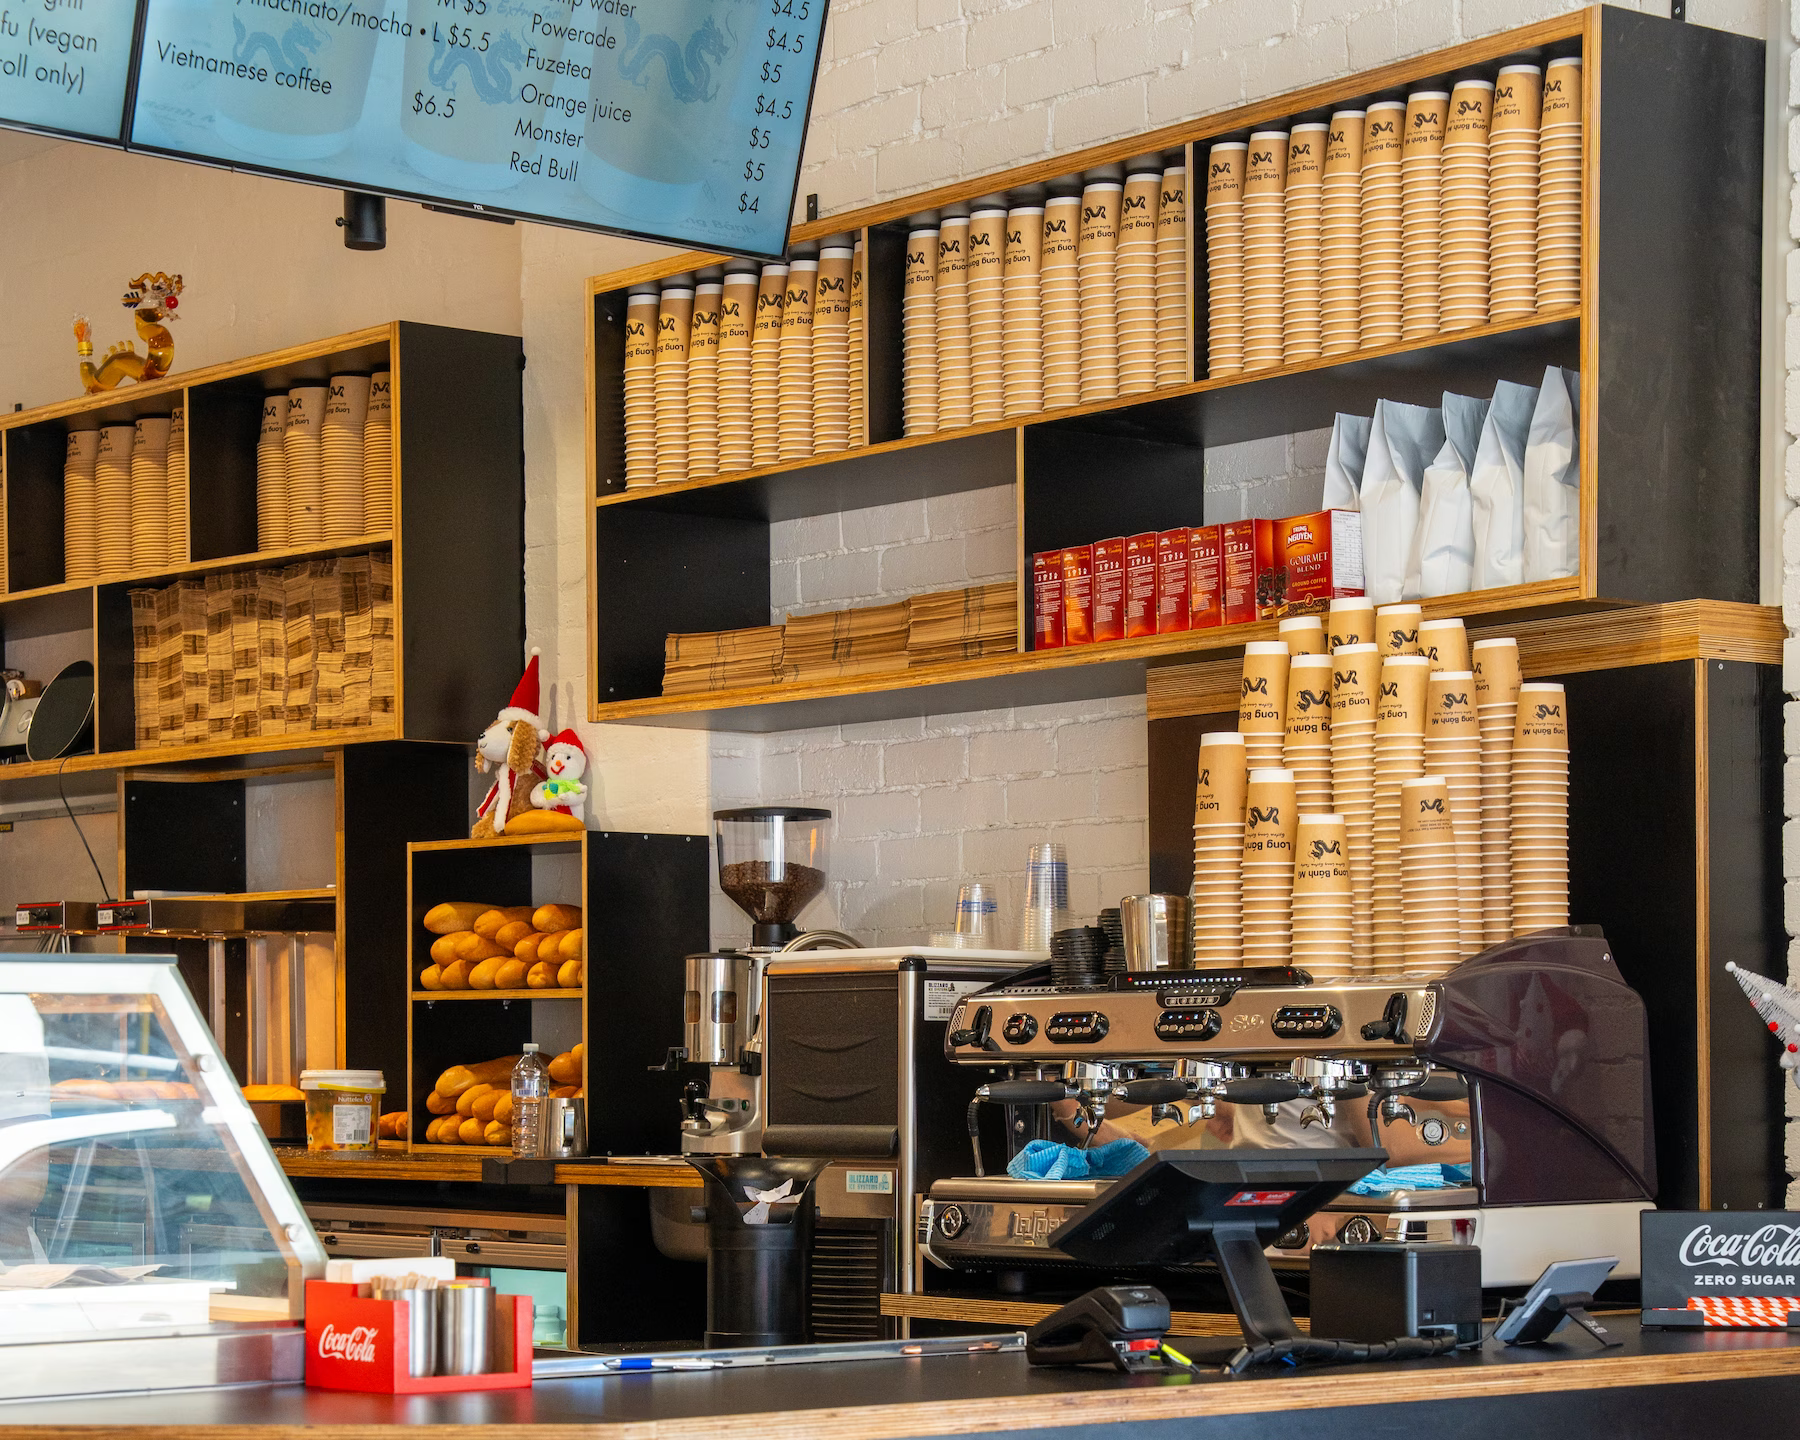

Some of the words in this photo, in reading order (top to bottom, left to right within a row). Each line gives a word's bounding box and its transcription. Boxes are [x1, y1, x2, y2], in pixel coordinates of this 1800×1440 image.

[463, 0, 487, 15] $5
[589, 0, 637, 18] water
[771, 0, 810, 20] $4.5
[236, 0, 412, 37] achiato/mocha
[433, 22, 440, 42] L
[447, 23, 491, 52] $5.5
[531, 13, 616, 49] Powerade
[28, 17, 98, 53] (vegan
[766, 26, 804, 53] $4.5
[157, 40, 268, 82] Vietnamese
[275, 67, 332, 94] coffee
[526, 48, 591, 80] Fuzetea
[0, 53, 28, 78] oll
[35, 62, 84, 95] only)
[760, 60, 782, 83] $5
[412, 90, 456, 118] $6.5
[521, 83, 587, 118] Orange
[592, 98, 632, 122] juice
[755, 93, 793, 119] $4.5
[514, 117, 584, 148] Monster
[1454, 123, 1470, 131] Bánh
[749, 126, 771, 149] $5
[1411, 136, 1428, 144] Bánh
[1385, 142, 1402, 150] Long
[510, 151, 543, 175] Red
[548, 158, 579, 182] Bull
[743, 158, 765, 182] $5
[738, 191, 759, 214] $4
[1135, 221, 1155, 229] Long
[1097, 230, 1116, 239] Long
[1057, 244, 1076, 252] Long
[1013, 255, 1030, 263] Long
[729, 329, 748, 337] Long
[635, 348, 655, 356] Long
[665, 343, 684, 352] Long
[1290, 552, 1328, 566] GOURMET
[1297, 564, 1321, 573] BLEND
[1348, 698, 1370, 706] Long
[1255, 710, 1279, 720] Long
[1387, 710, 1407, 719] Long
[1293, 724, 1318, 734] Bánh
[1553, 727, 1565, 736] Long
[1199, 801, 1219, 811] Long
[1266, 839, 1291, 850] Long
[1308, 870, 1330, 879] Bánh
[1334, 868, 1349, 878] Long
[849, 1175, 878, 1183] BLIZZARD
[1694, 1275, 1736, 1286] ZERO
[1741, 1275, 1796, 1286] SUGAR
[319, 1324, 379, 1362] Coca-Cola
